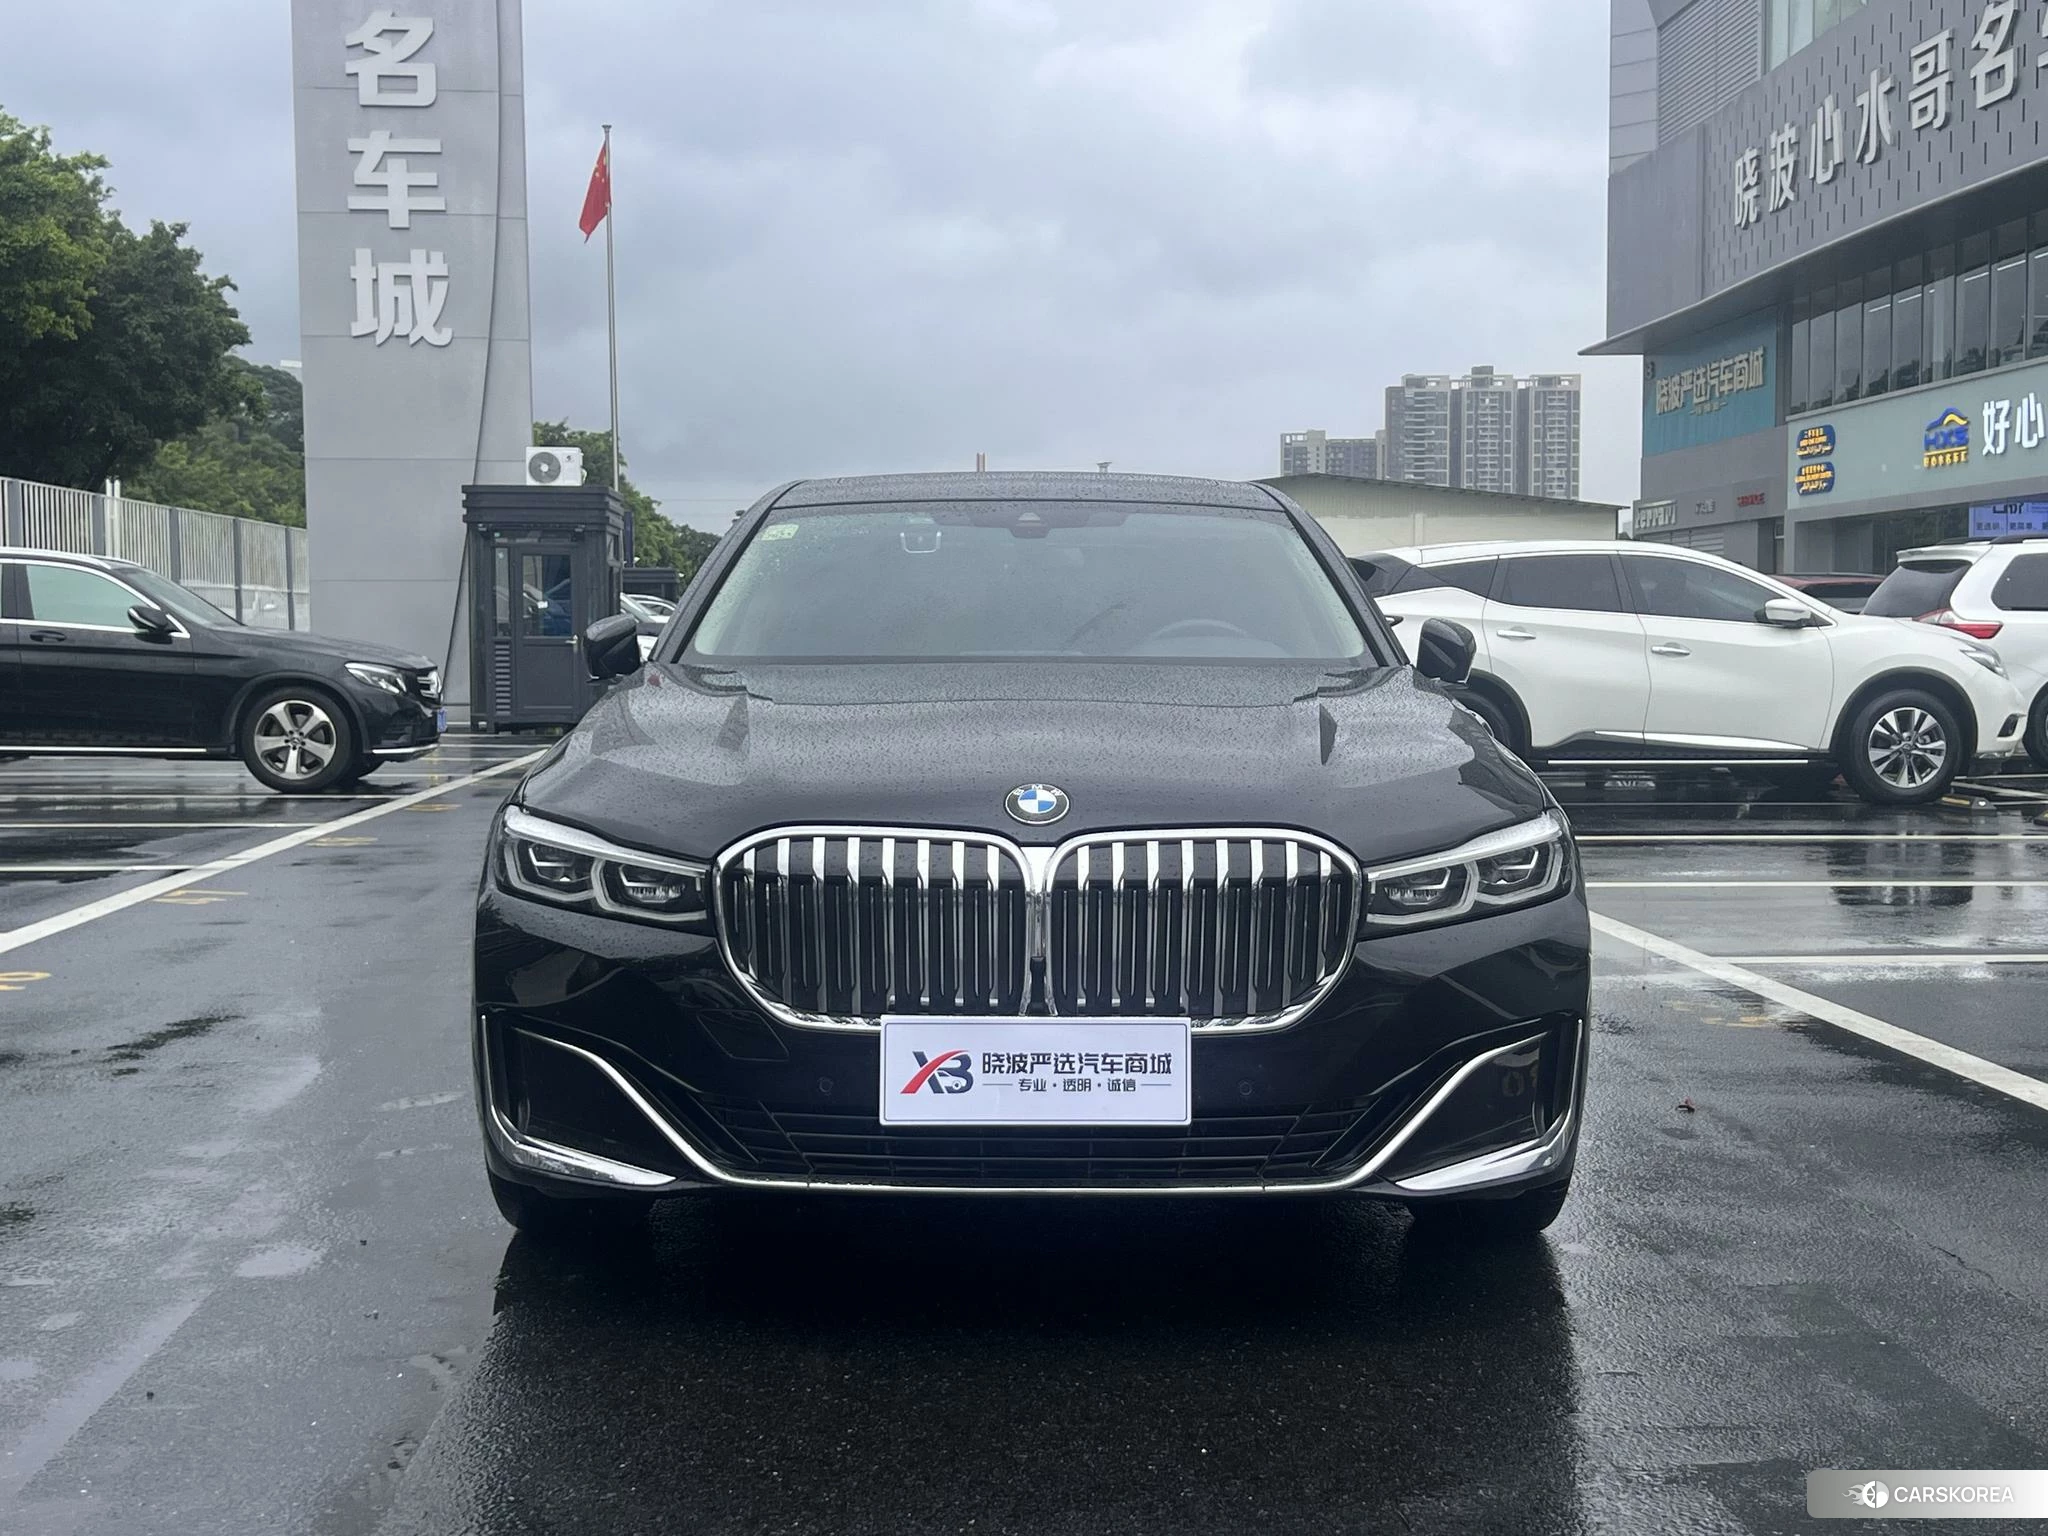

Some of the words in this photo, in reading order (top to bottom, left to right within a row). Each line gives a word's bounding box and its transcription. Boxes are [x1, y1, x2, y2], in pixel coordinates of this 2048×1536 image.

[1733, 0, 2048, 229] 晓波心水哥名
[345, 10, 453, 348] 名车城
[1982, 392, 2046, 456] 好心
[1013, 783, 1063, 796] BMW
[982, 1051, 1172, 1075] 晓波严选汽车商城
